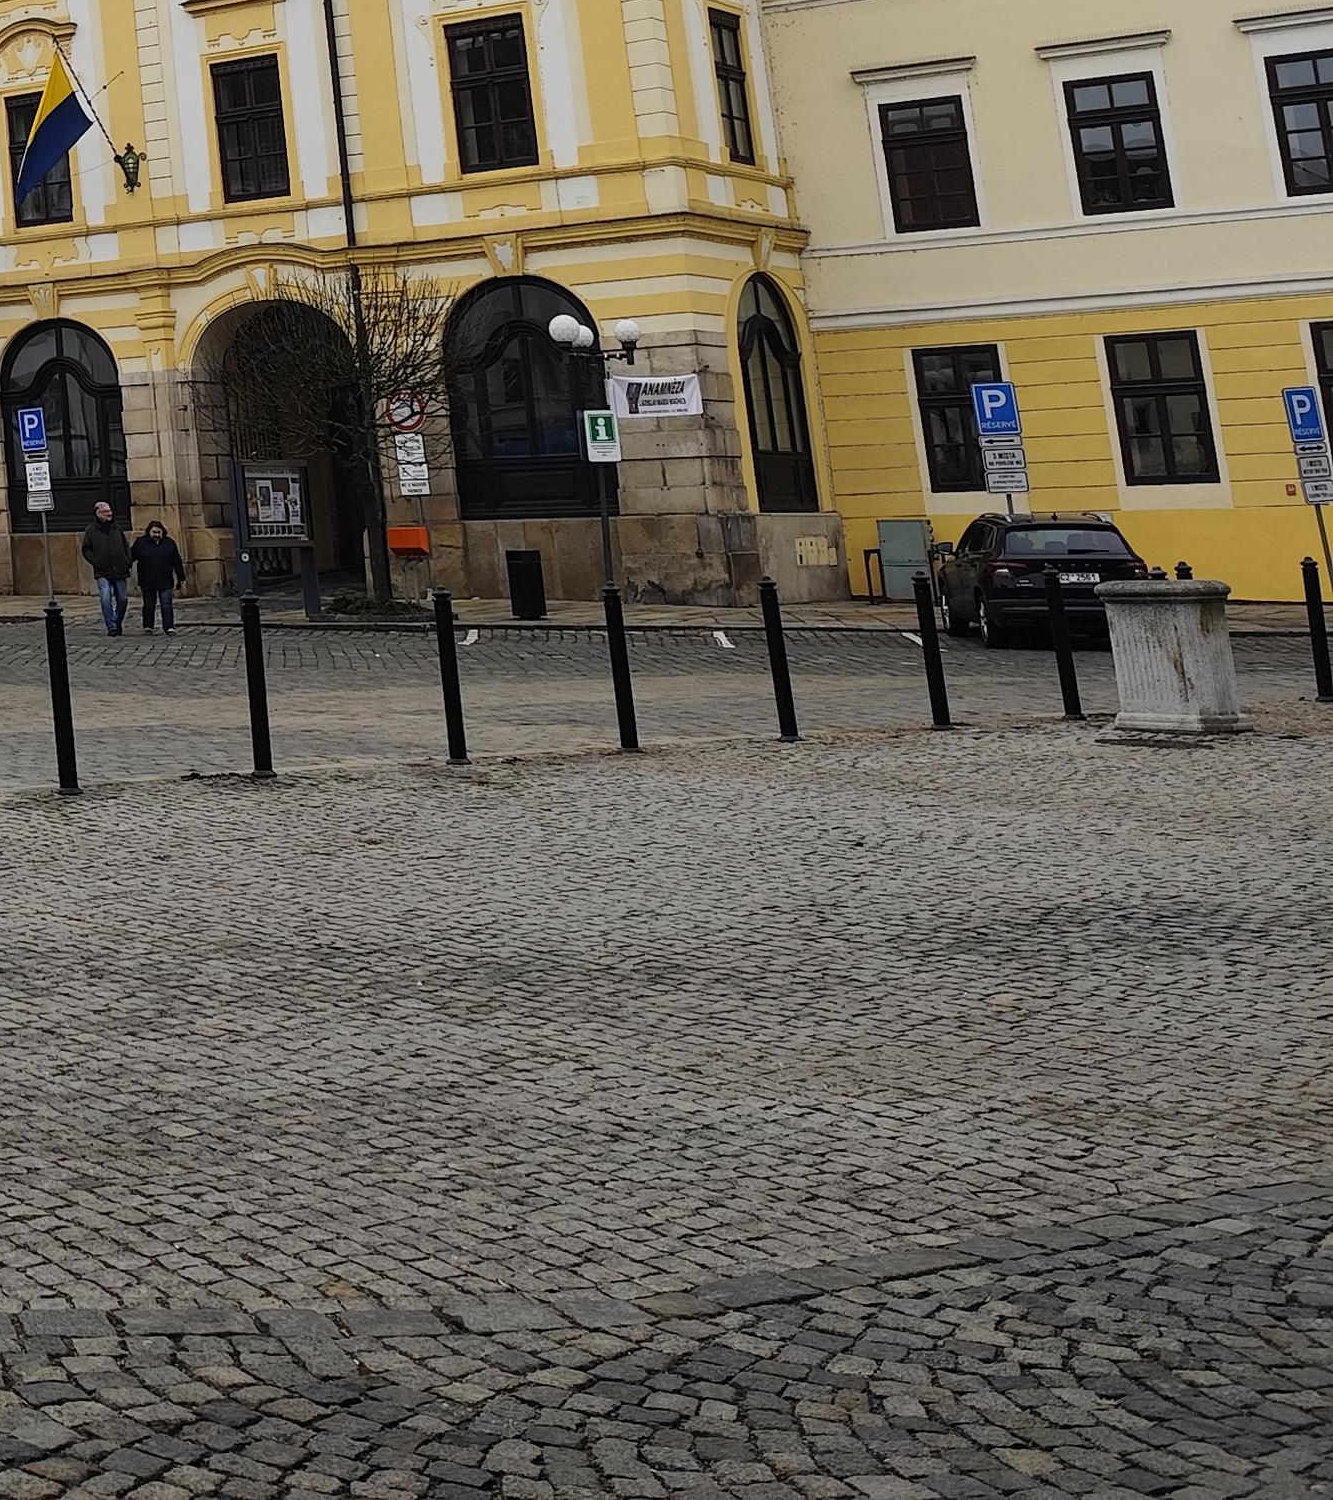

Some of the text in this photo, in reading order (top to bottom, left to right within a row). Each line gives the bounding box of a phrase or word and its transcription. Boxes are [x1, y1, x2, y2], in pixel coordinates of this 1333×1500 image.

[981, 389, 1007, 419] P
[1291, 394, 1312, 425] P
[23, 414, 39, 438] P
